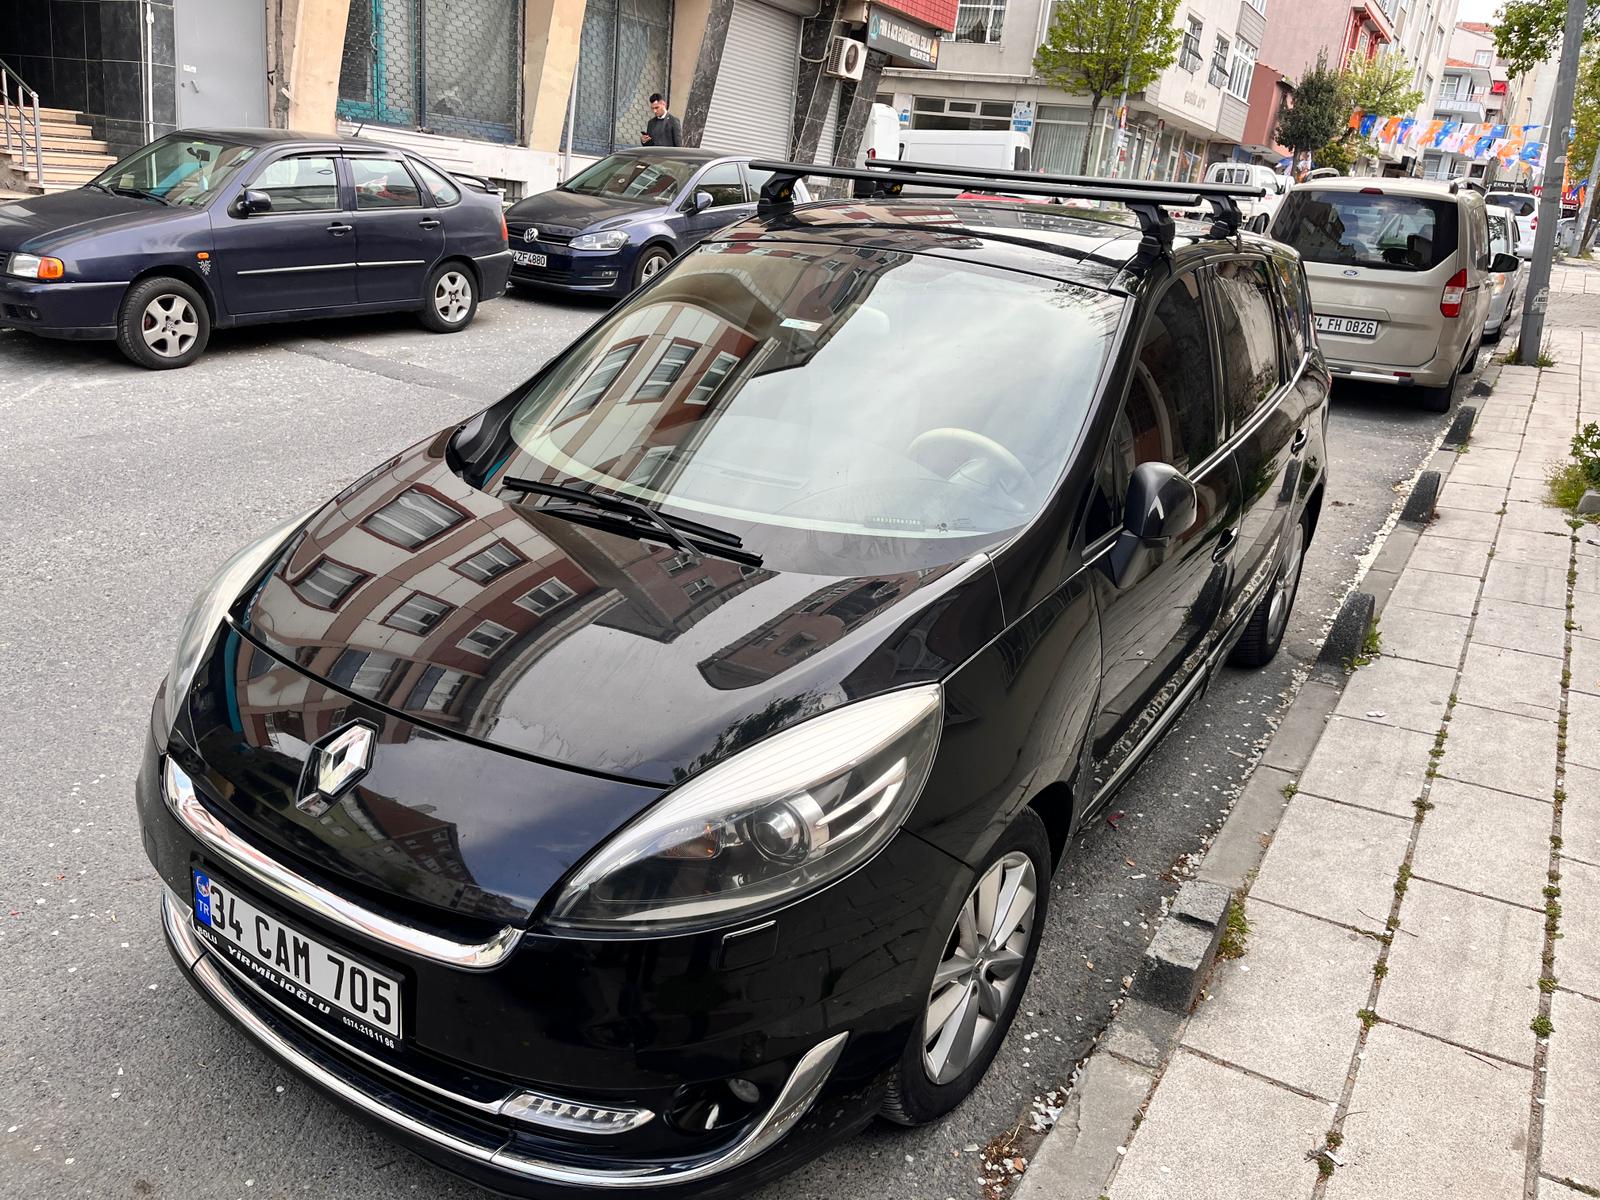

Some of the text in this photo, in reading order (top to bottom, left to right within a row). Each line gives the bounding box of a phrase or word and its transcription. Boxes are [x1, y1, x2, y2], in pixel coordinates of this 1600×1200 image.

[1327, 319, 1342, 331] FH
[1345, 321, 1374, 334] 0826
[197, 899, 210, 916] TR
[210, 886, 391, 1025] 34 CAM 705
